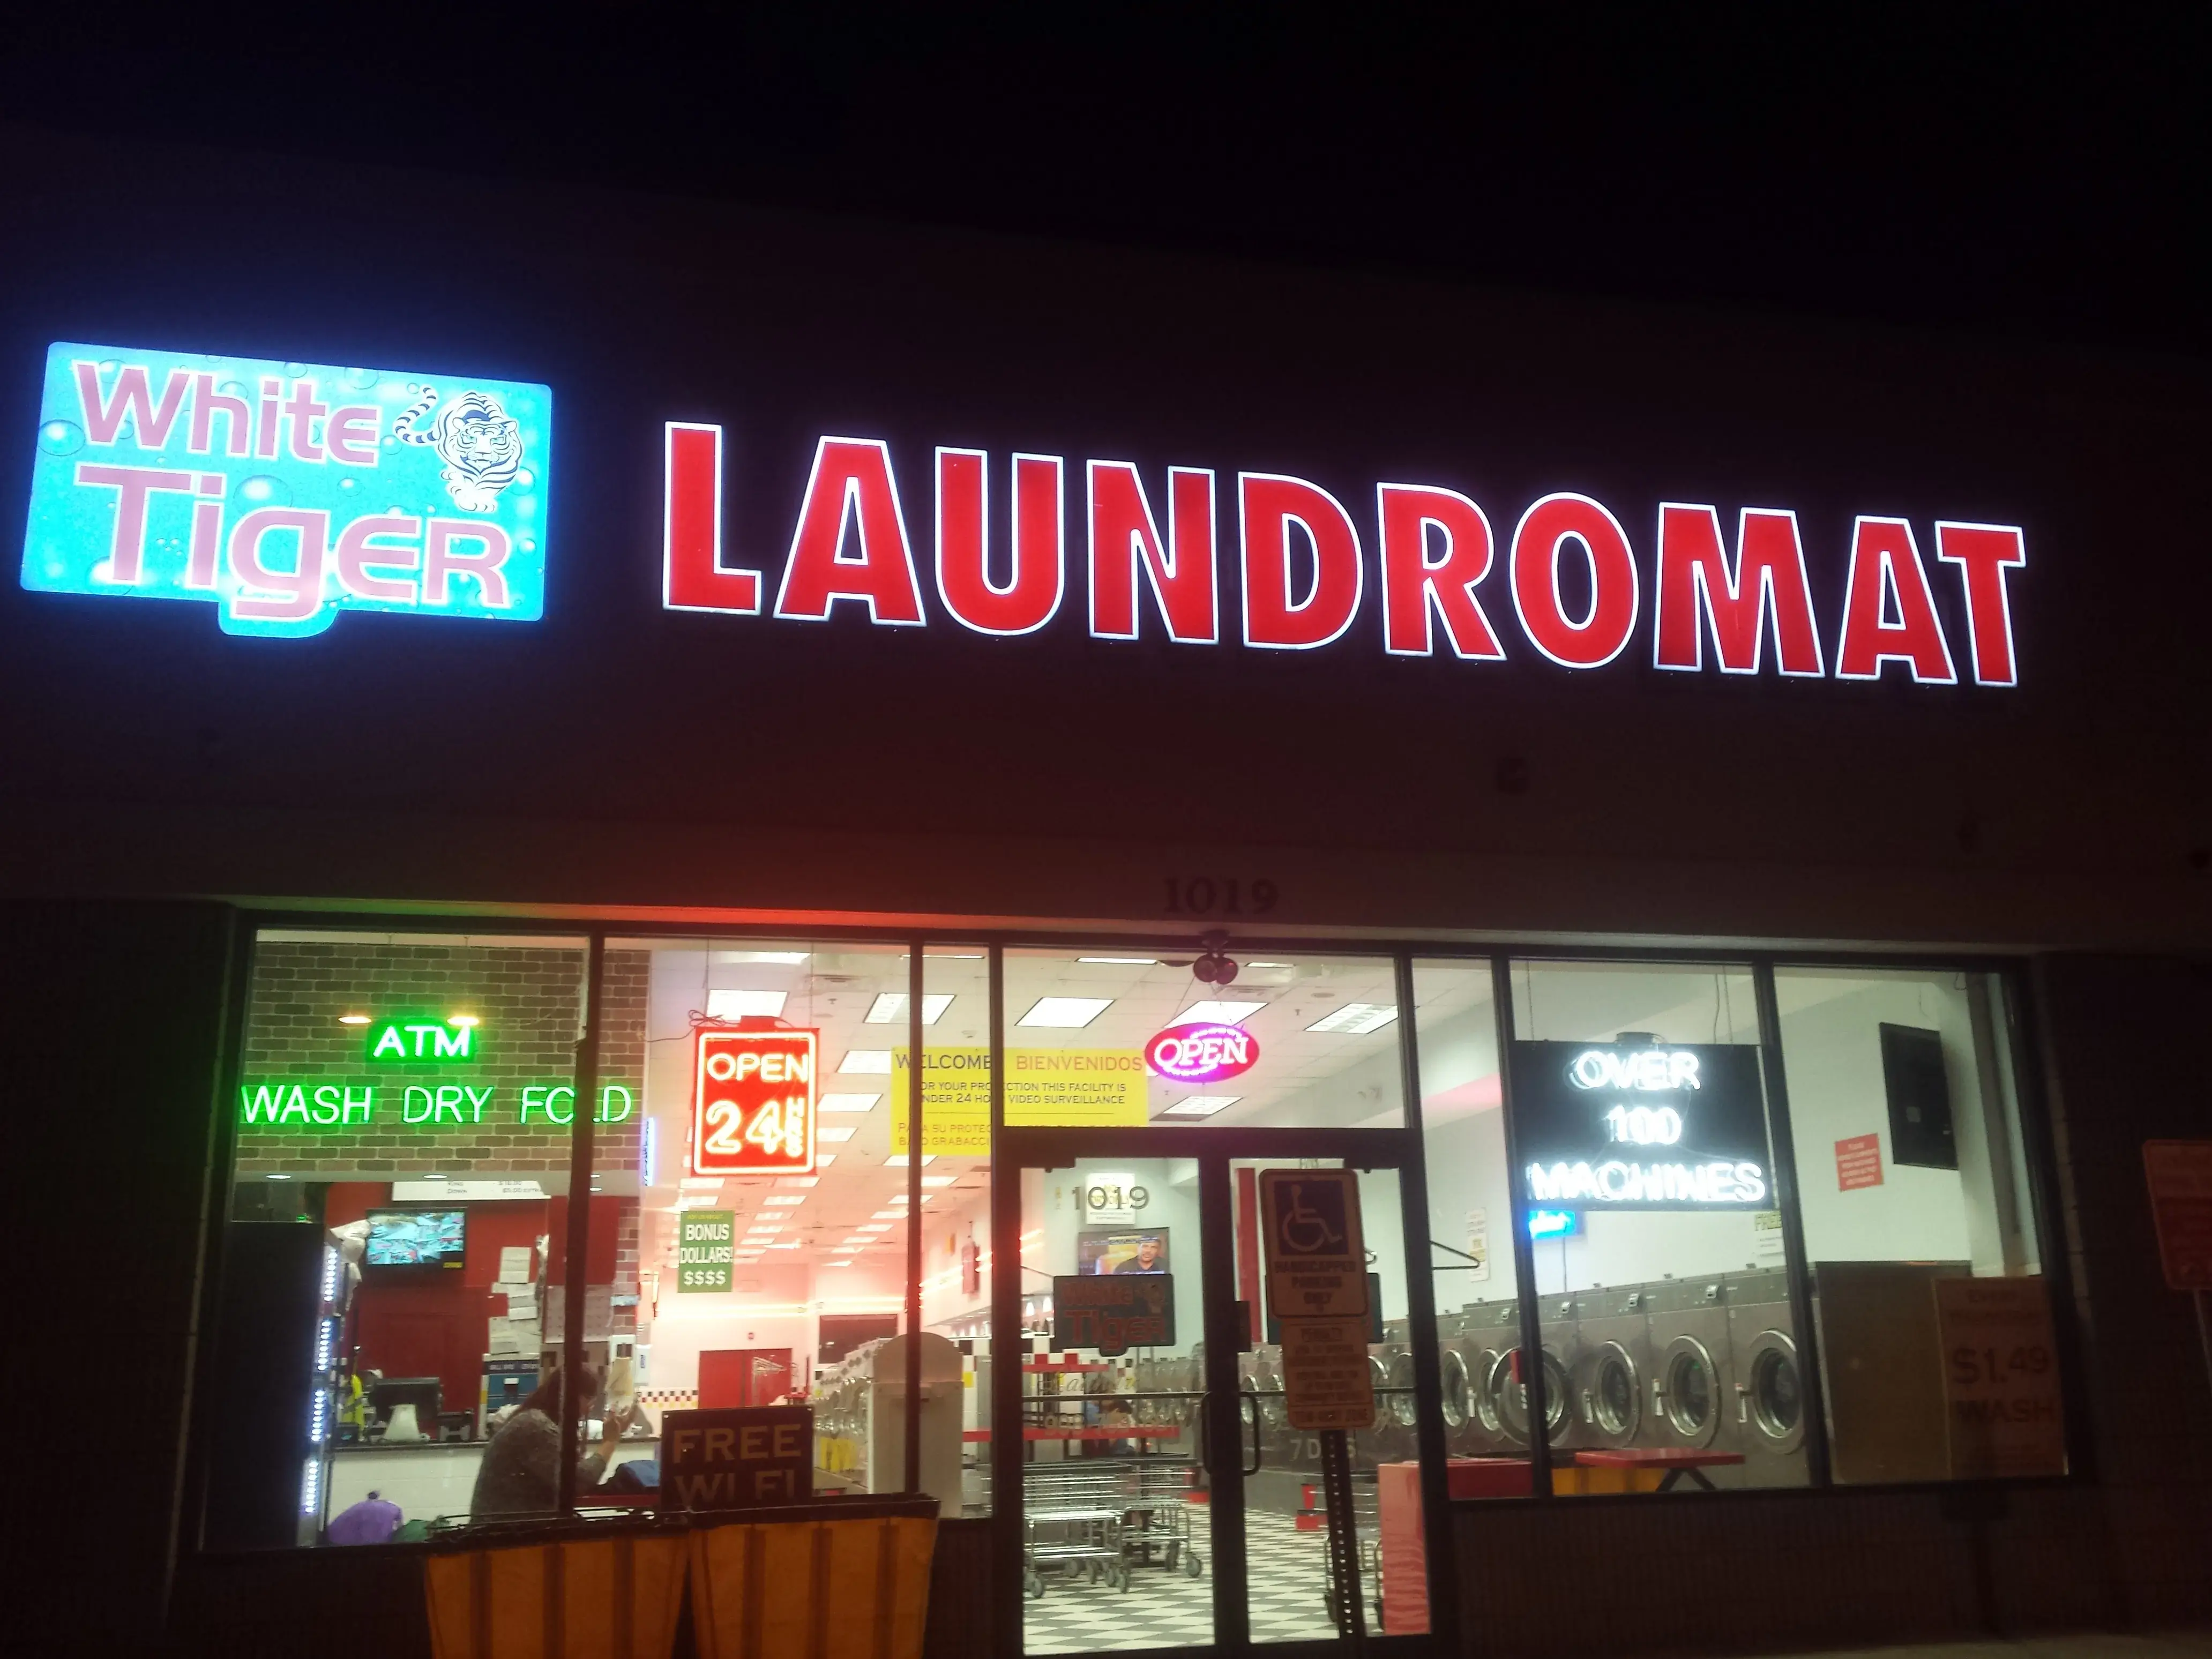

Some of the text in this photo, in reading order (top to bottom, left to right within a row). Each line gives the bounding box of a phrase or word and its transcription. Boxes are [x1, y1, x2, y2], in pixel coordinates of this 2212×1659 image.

[662, 421, 2027, 687] LAUNDROMAT
[1163, 876, 1280, 914] 1019
[373, 1024, 472, 1058] ATM
[1154, 1037, 1249, 1068] OPEN
[706, 1052, 810, 1082] OPEN
[1016, 1055, 1143, 1071] BIENVENIDOS
[1568, 1050, 1702, 1090] OVER
[922, 1094, 953, 1103] NDER
[956, 1093, 972, 1103] 24
[1009, 1095, 1041, 1104] VIDEO
[1044, 1095, 1126, 1104] SURVEILLANCE
[939, 1082, 967, 1090] YOUR
[971, 1082, 1038, 1092] PROCTION
[1042, 1082, 1066, 1091] THIS
[1069, 1083, 1114, 1092] FACILITY
[1117, 1083, 1126, 1092] IS
[240, 1084, 634, 1124] WASH DRY FOD
[705, 1099, 784, 1154] 24
[933, 1124, 946, 1133] SU
[1604, 1104, 1683, 1145] 100
[1527, 1161, 1766, 1202] MACHINES
[1072, 1186, 1150, 1210] 1019
[685, 1223, 730, 1241] BONUS
[683, 1269, 726, 1287] $$$$
[1951, 1344, 2050, 1389] $1.49
[1956, 1398, 2056, 1423] WASH
[673, 1423, 802, 1464] FREE
[1289, 1438, 1303, 1462] 7
[673, 1469, 795, 1508] WI FI
